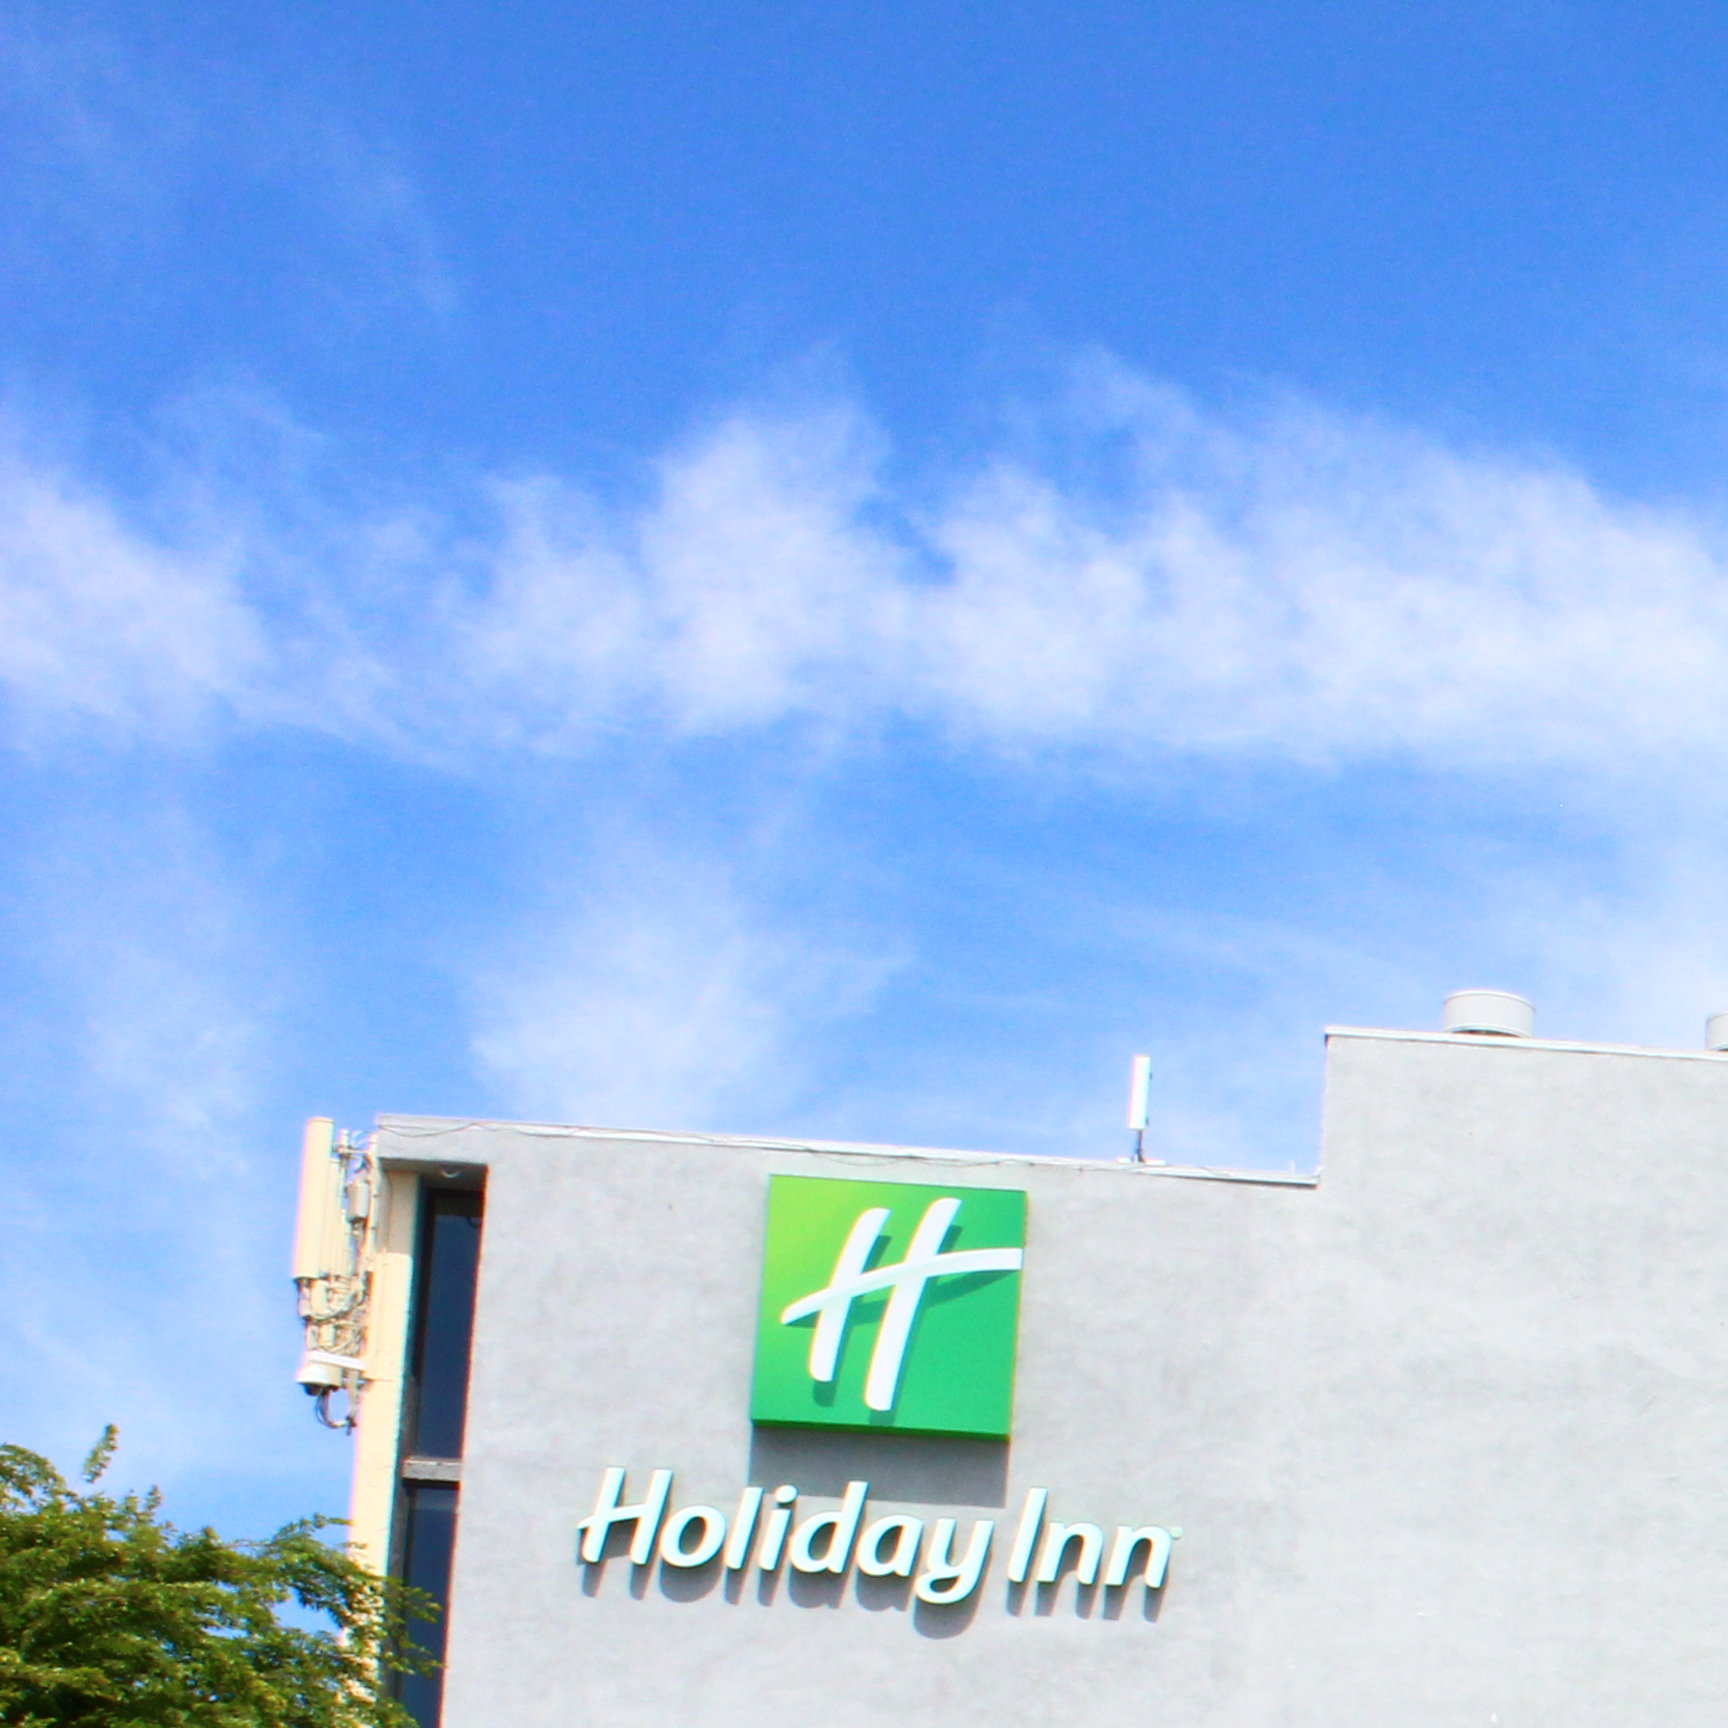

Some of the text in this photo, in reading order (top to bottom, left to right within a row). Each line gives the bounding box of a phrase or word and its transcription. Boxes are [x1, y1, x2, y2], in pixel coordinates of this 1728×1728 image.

[780, 1197, 1023, 1411] H
[577, 1466, 1175, 1605] Holiday Inn
